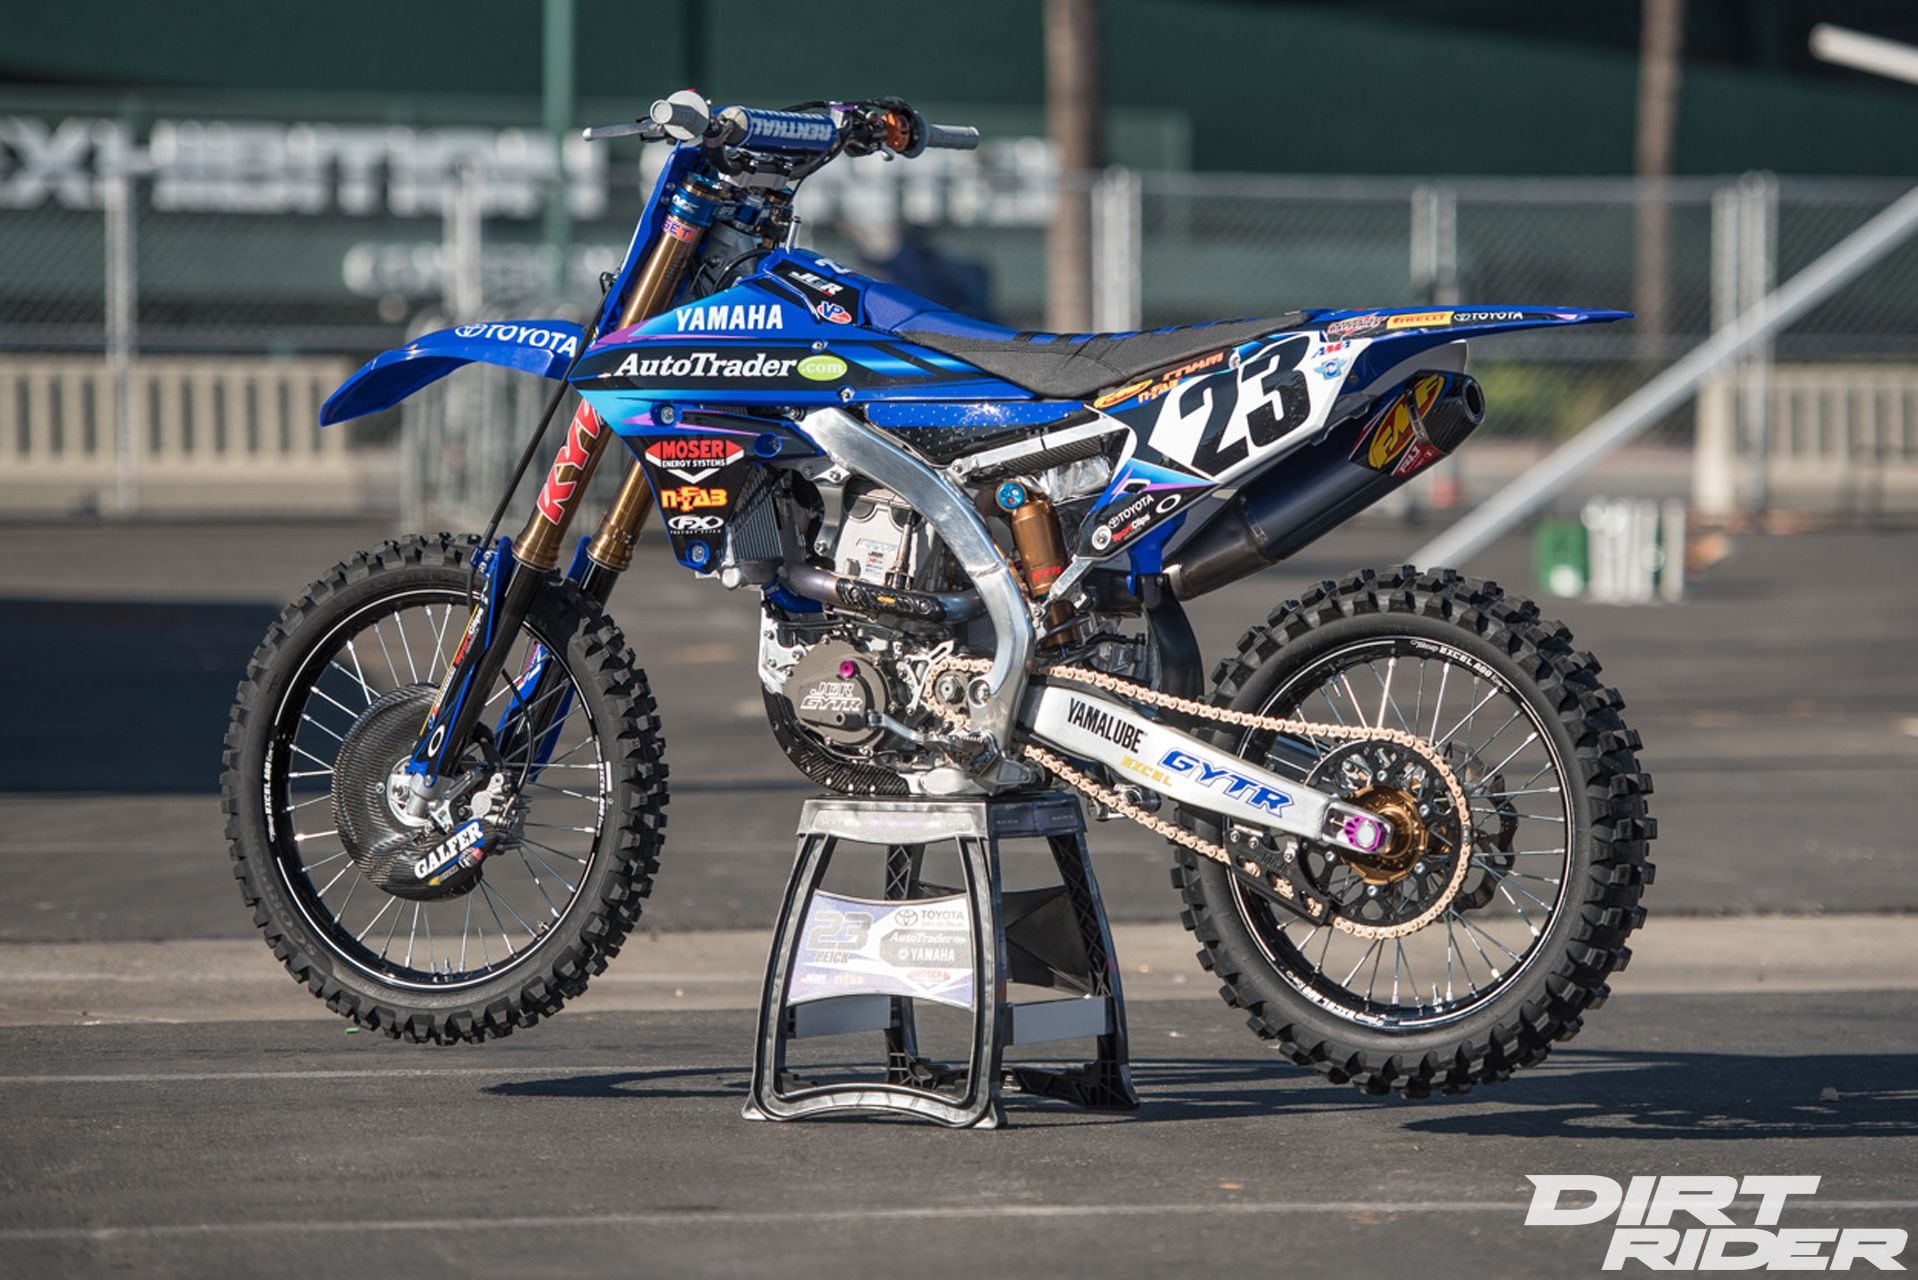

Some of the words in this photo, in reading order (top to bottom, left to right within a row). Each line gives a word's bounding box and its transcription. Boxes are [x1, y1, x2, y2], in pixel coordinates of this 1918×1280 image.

[752, 117, 832, 141] RENTHAL
[676, 304, 783, 332] YAMAHA
[1392, 312, 1447, 324] PIRELLI
[1471, 311, 1524, 321] TOYOTA
[485, 324, 578, 358] TOYOTA
[1178, 335, 1312, 477] 23
[662, 439, 725, 459] MOSER
[662, 460, 690, 468] ENERGY
[1118, 494, 1155, 522] TOYOTA
[1439, 646, 1473, 667] EXCEL
[1066, 697, 1142, 754] YAMALUBE
[1120, 754, 1173, 787] EXCEL
[1157, 748, 1294, 819] GYTR
[414, 821, 485, 879] GALFER
[921, 909, 964, 920] TOYOTA
[910, 947, 956, 963] YAMAHA
